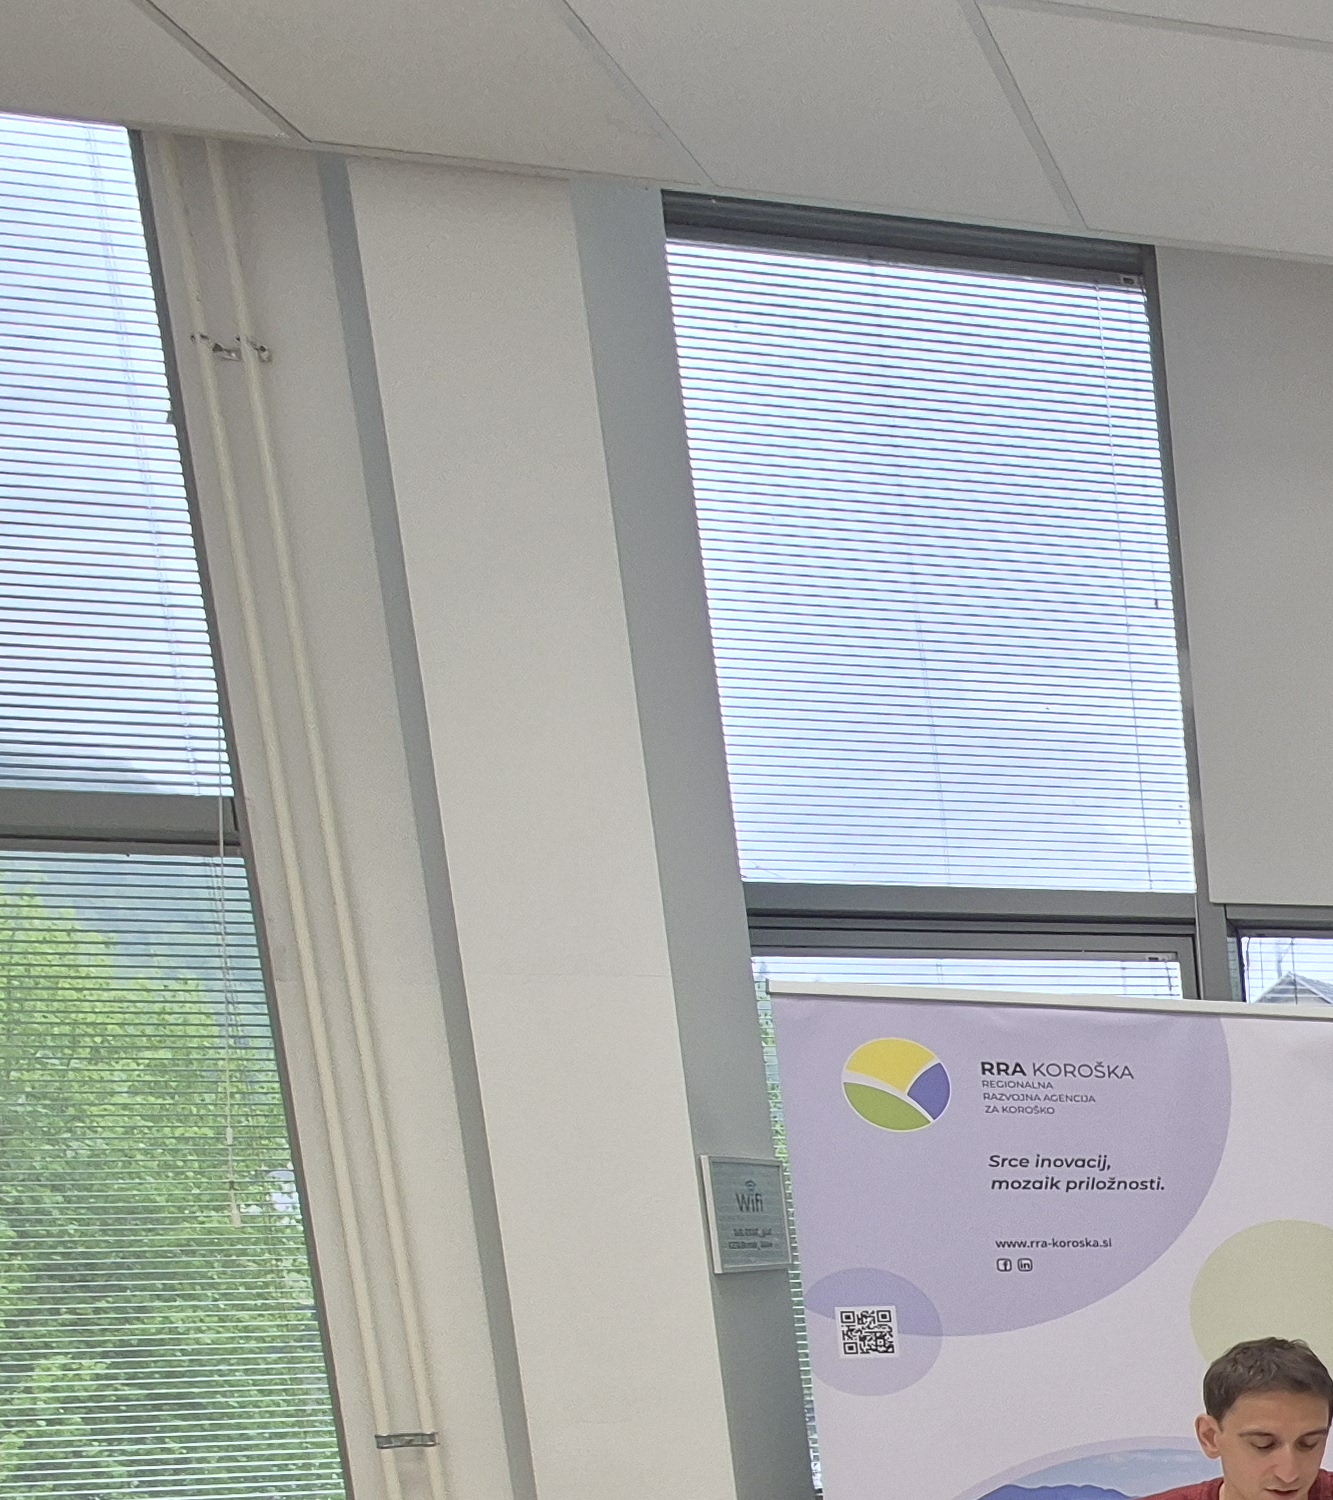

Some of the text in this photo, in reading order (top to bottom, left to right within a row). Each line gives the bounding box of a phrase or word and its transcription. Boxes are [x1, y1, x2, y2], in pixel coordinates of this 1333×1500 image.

[980, 1061, 1135, 1080] RRA KOROŠKA
[982, 1080, 1054, 1089] REGIONALNA
[983, 1093, 1096, 1103] RAZVOJNA AGENCIJA
[985, 1105, 1055, 1115] ZA KOROŠKO
[988, 1154, 1111, 1171] Srce inovacij,
[991, 1176, 1165, 1192] mozaik priložnosti.
[995, 1238, 1112, 1248] www.rra-koroska.si
